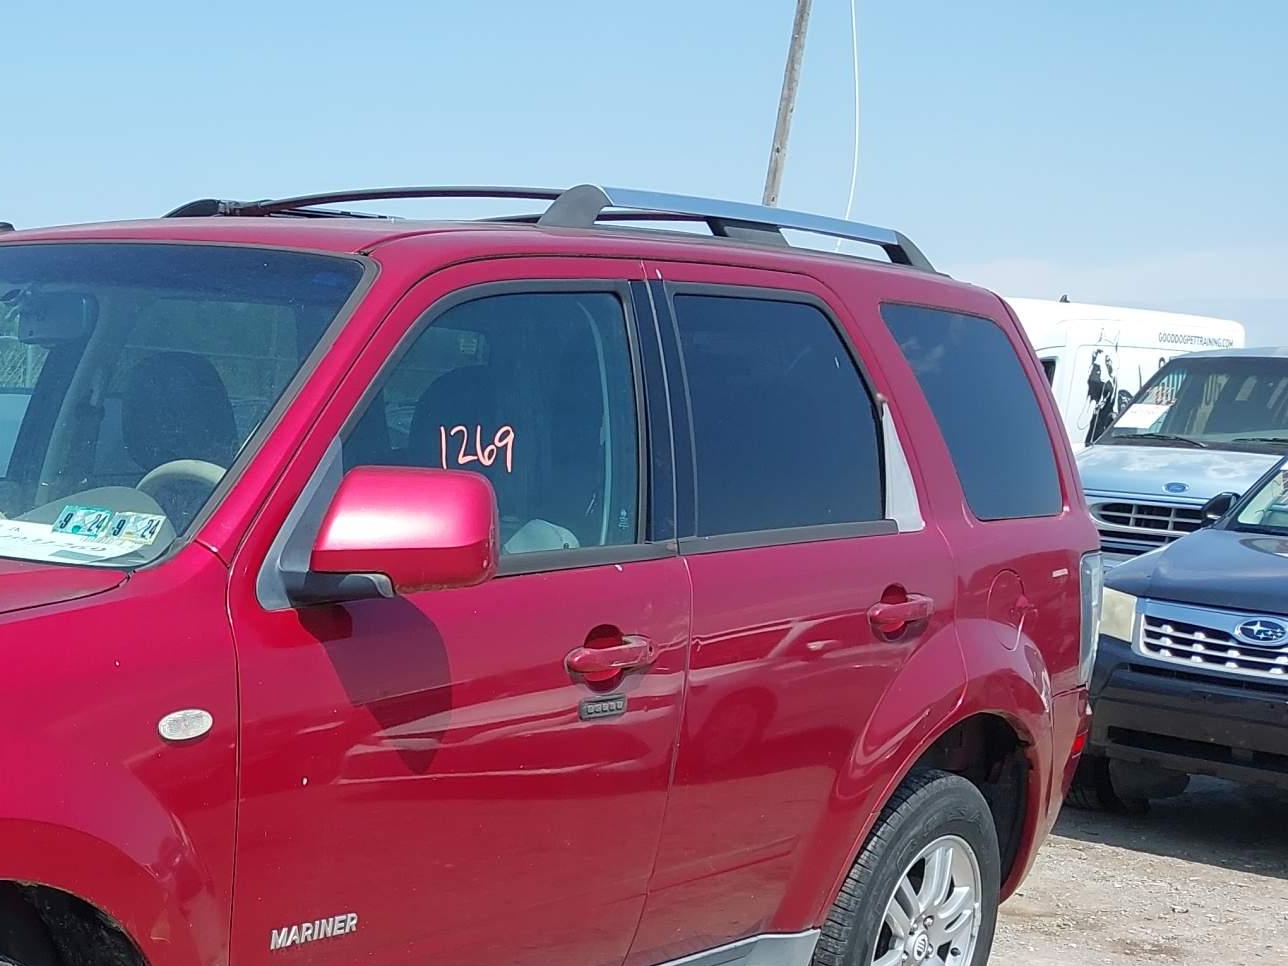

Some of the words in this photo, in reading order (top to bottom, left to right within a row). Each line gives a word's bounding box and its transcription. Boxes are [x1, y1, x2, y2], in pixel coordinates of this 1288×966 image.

[440, 425, 514, 472] 1269
[87, 513, 108, 533] 24
[141, 519, 161, 539] 24
[270, 913, 358, 950] MARINER
